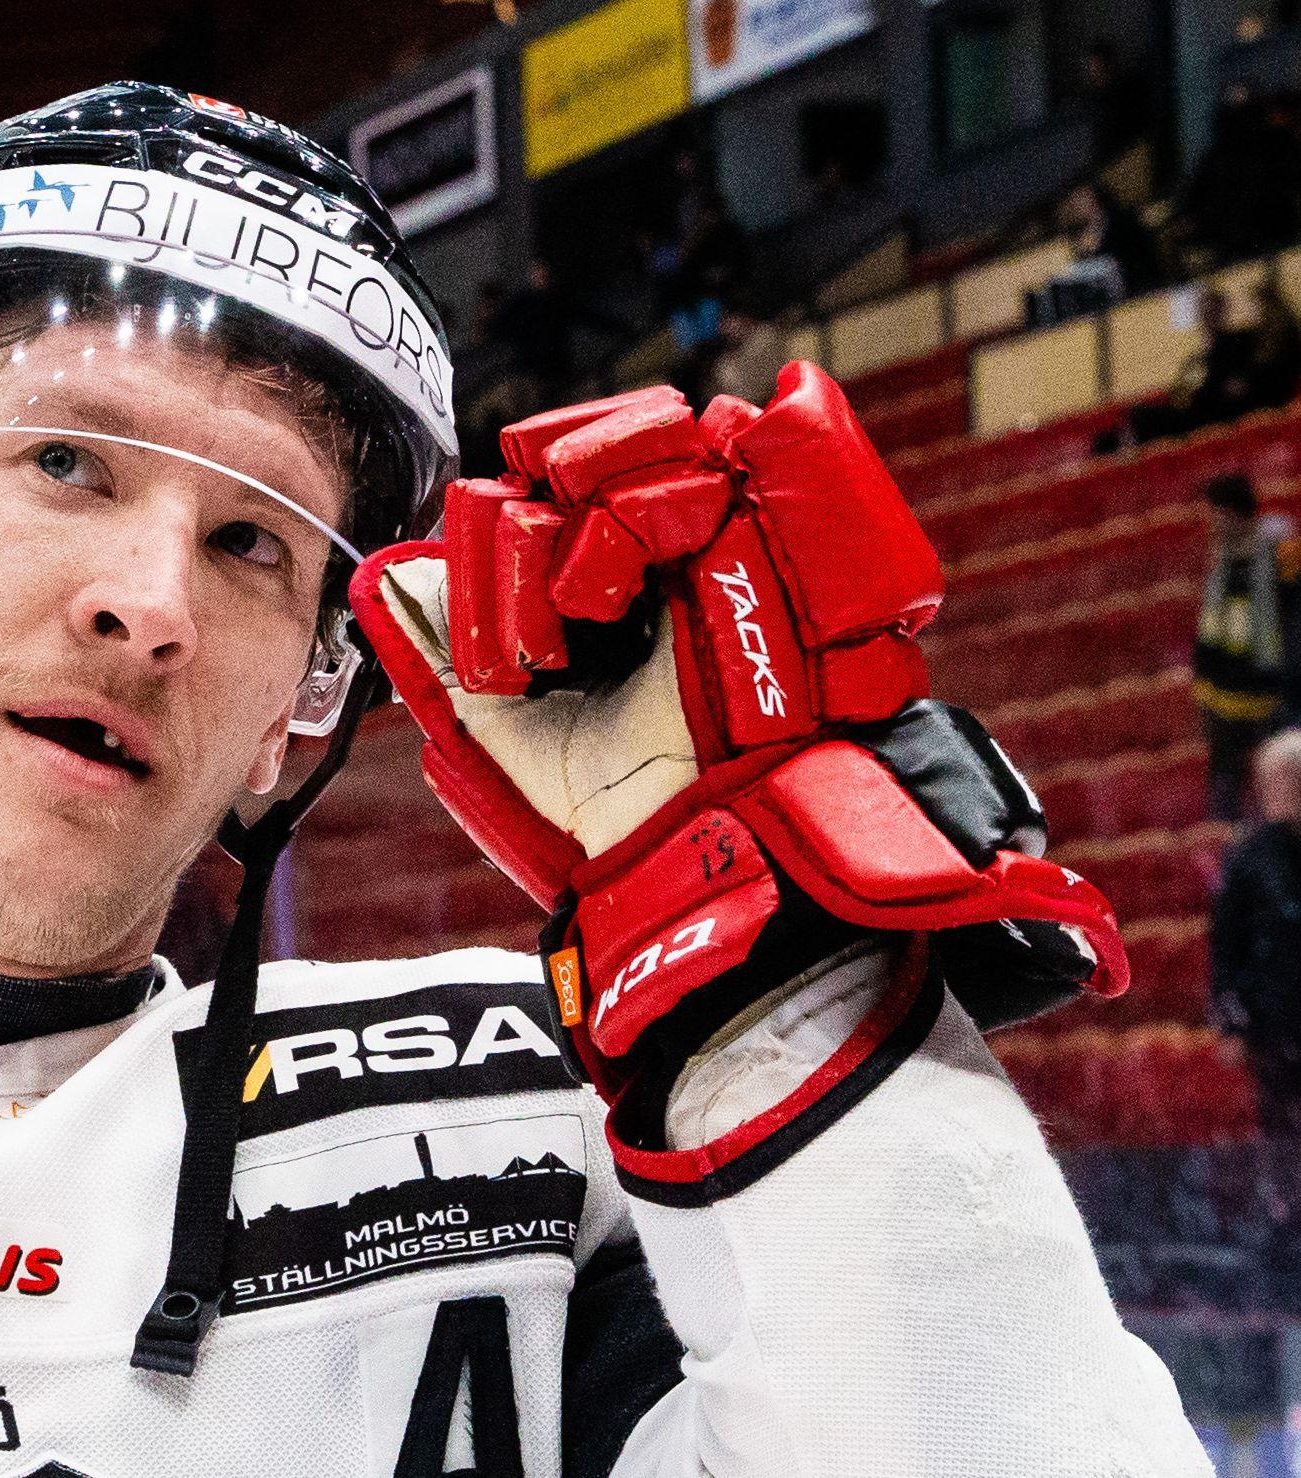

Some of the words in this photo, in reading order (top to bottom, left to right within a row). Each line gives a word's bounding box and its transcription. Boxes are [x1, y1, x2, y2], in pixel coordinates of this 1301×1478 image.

[183, 151, 359, 237] CCM
[96, 180, 447, 419] BJURFORS
[711, 561, 788, 718] TACKS
[594, 918, 716, 1029] CCM
[243, 1006, 561, 1103] RSA
[232, 1219, 578, 1296] STÄLLNINGSSERVICE
[345, 1203, 470, 1249] MALMÖ
[393, 1294, 526, 1478] A
